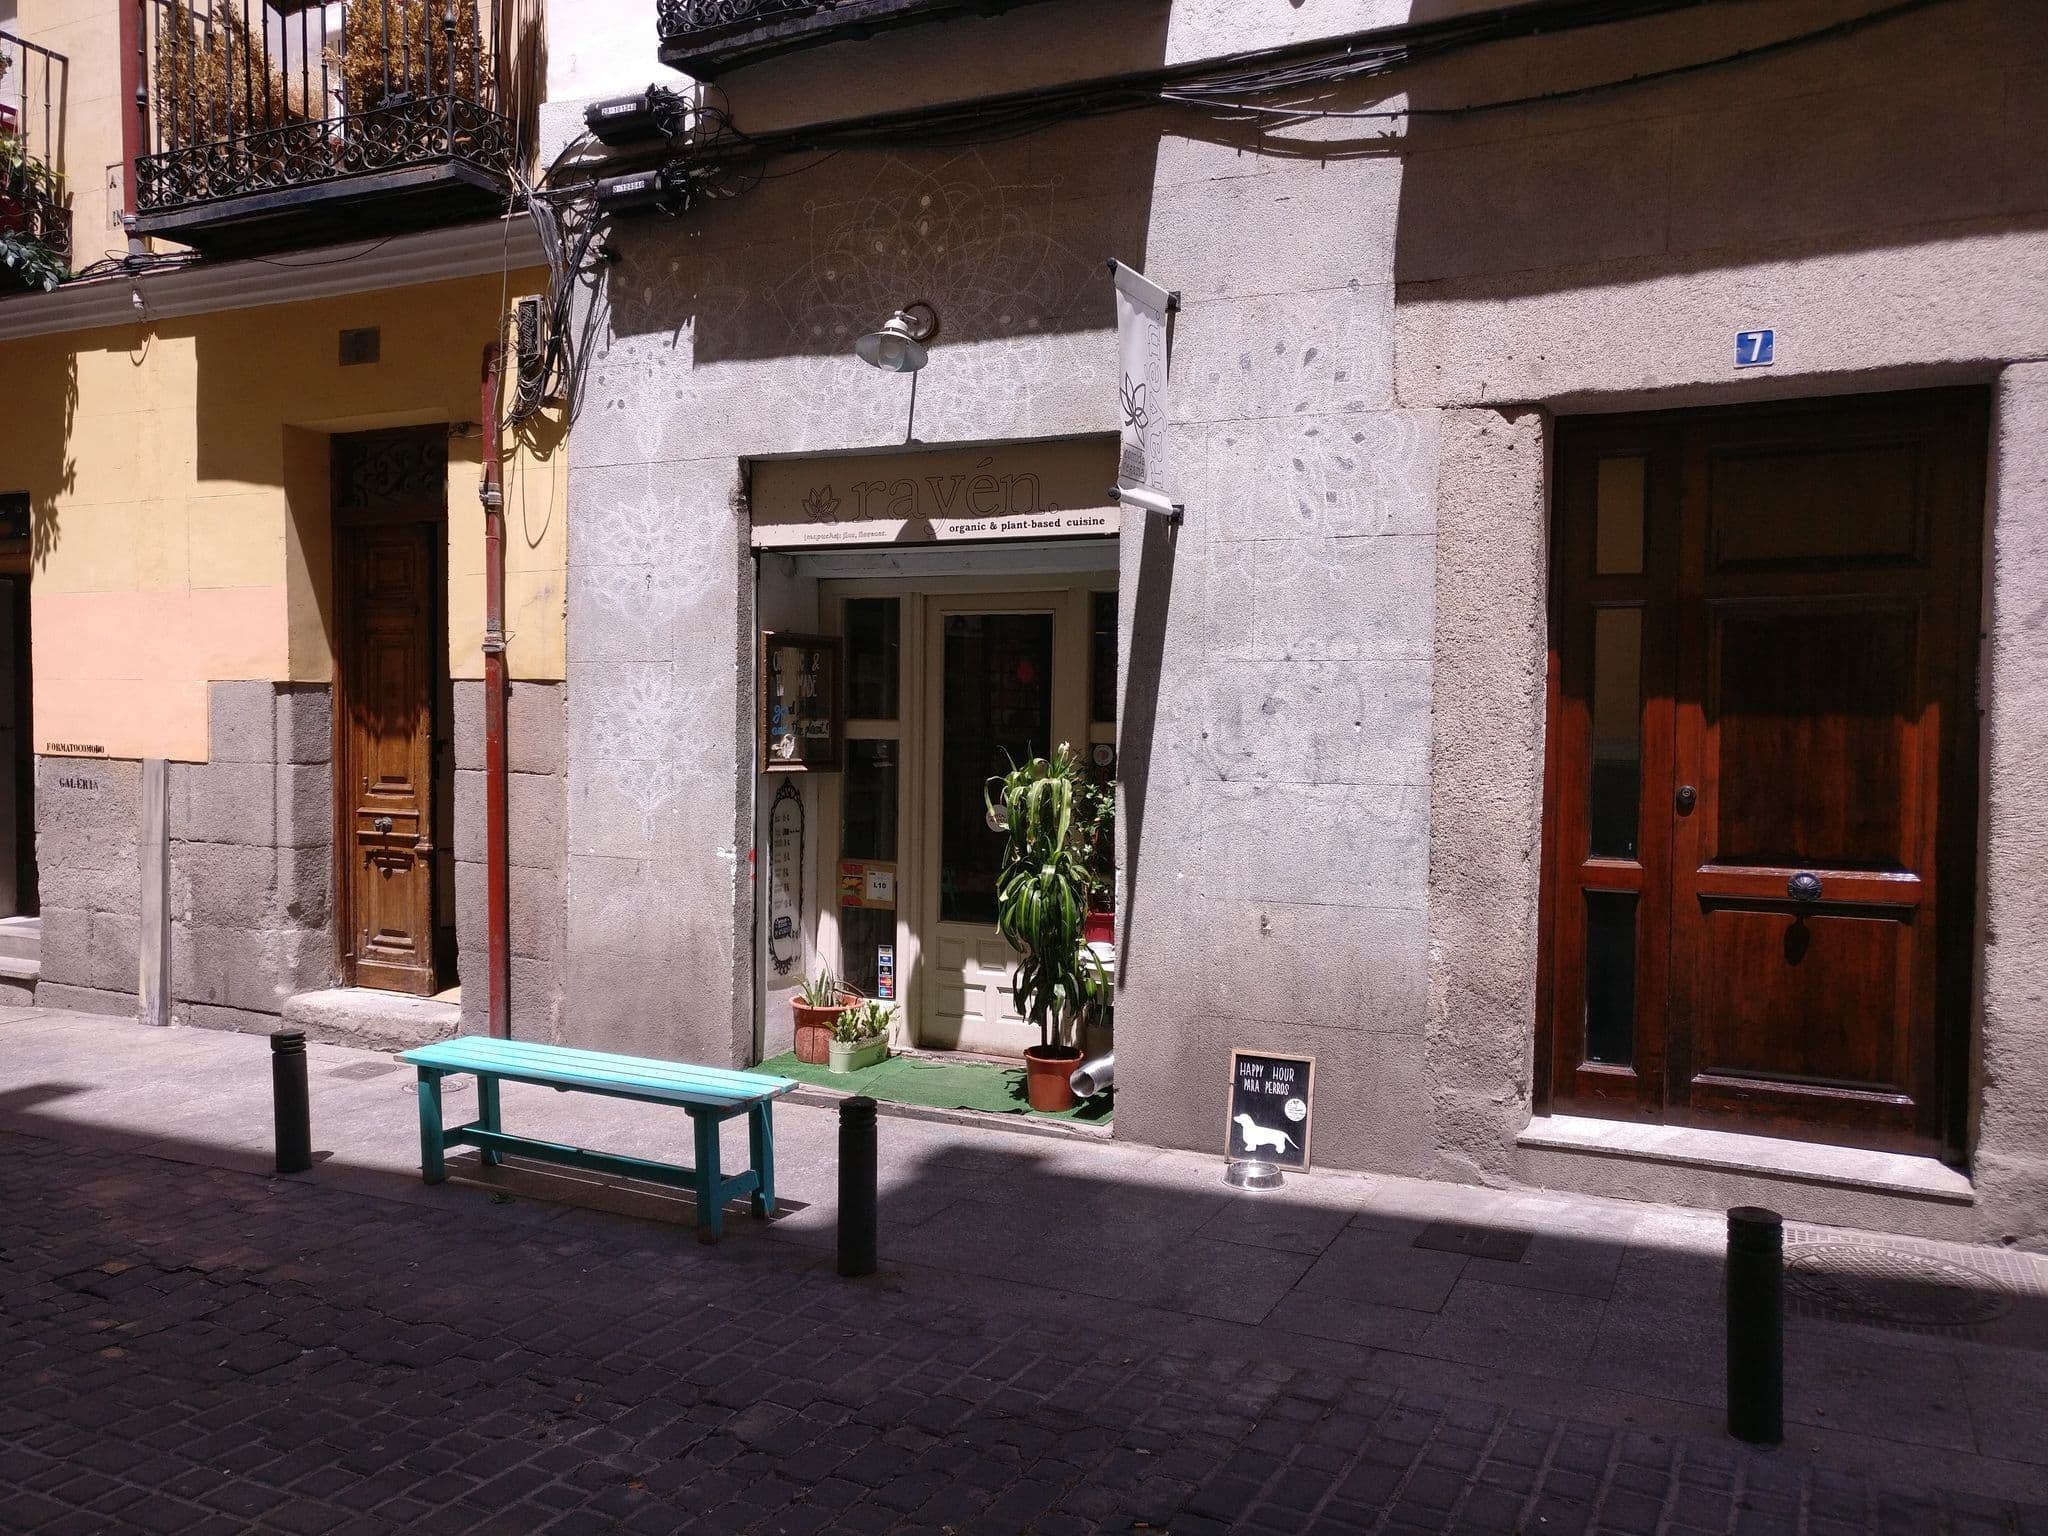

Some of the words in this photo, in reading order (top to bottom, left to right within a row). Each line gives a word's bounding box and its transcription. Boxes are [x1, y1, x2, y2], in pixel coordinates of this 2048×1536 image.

[1747, 332, 1764, 362] 7
[949, 522, 987, 534] organic
[989, 521, 998, 531] &
[1001, 518, 1061, 532] plant-based
[1066, 516, 1106, 528] cuisine
[46, 742, 105, 754] FORMATOCOMODO
[1240, 1062, 1264, 1078] HAPPY
[1272, 1066, 1295, 1082] HOUR
[1243, 1078, 1260, 1092] PARA
[1265, 1080, 1290, 1096] PERROS
